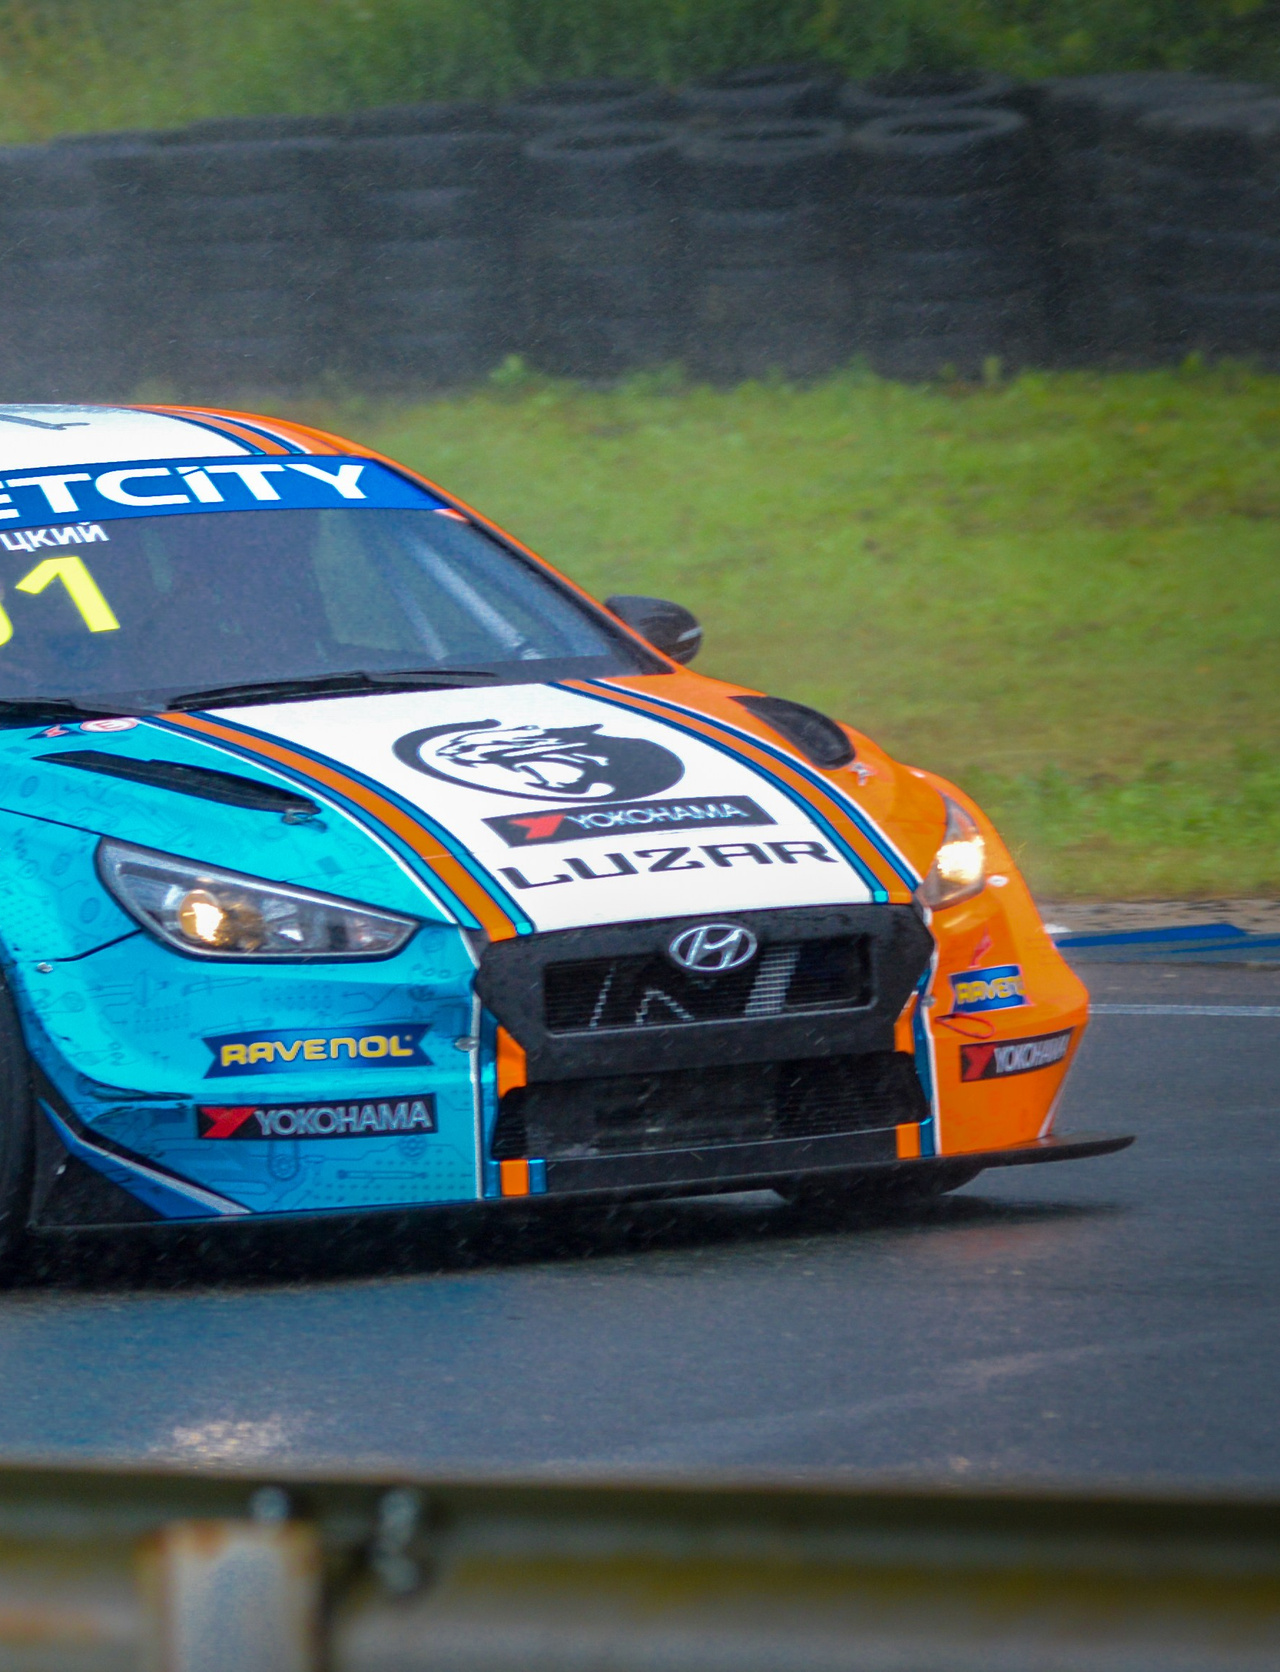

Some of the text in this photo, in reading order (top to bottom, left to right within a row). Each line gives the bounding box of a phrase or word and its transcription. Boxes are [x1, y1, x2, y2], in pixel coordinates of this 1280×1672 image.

[565, 802, 750, 830] YOKOHAMA
[497, 841, 840, 890] LUZAR
[955, 975, 1026, 1005] RAVEN
[221, 1034, 415, 1067] RAVENOL
[254, 1100, 433, 1136] YOKOHAMA
